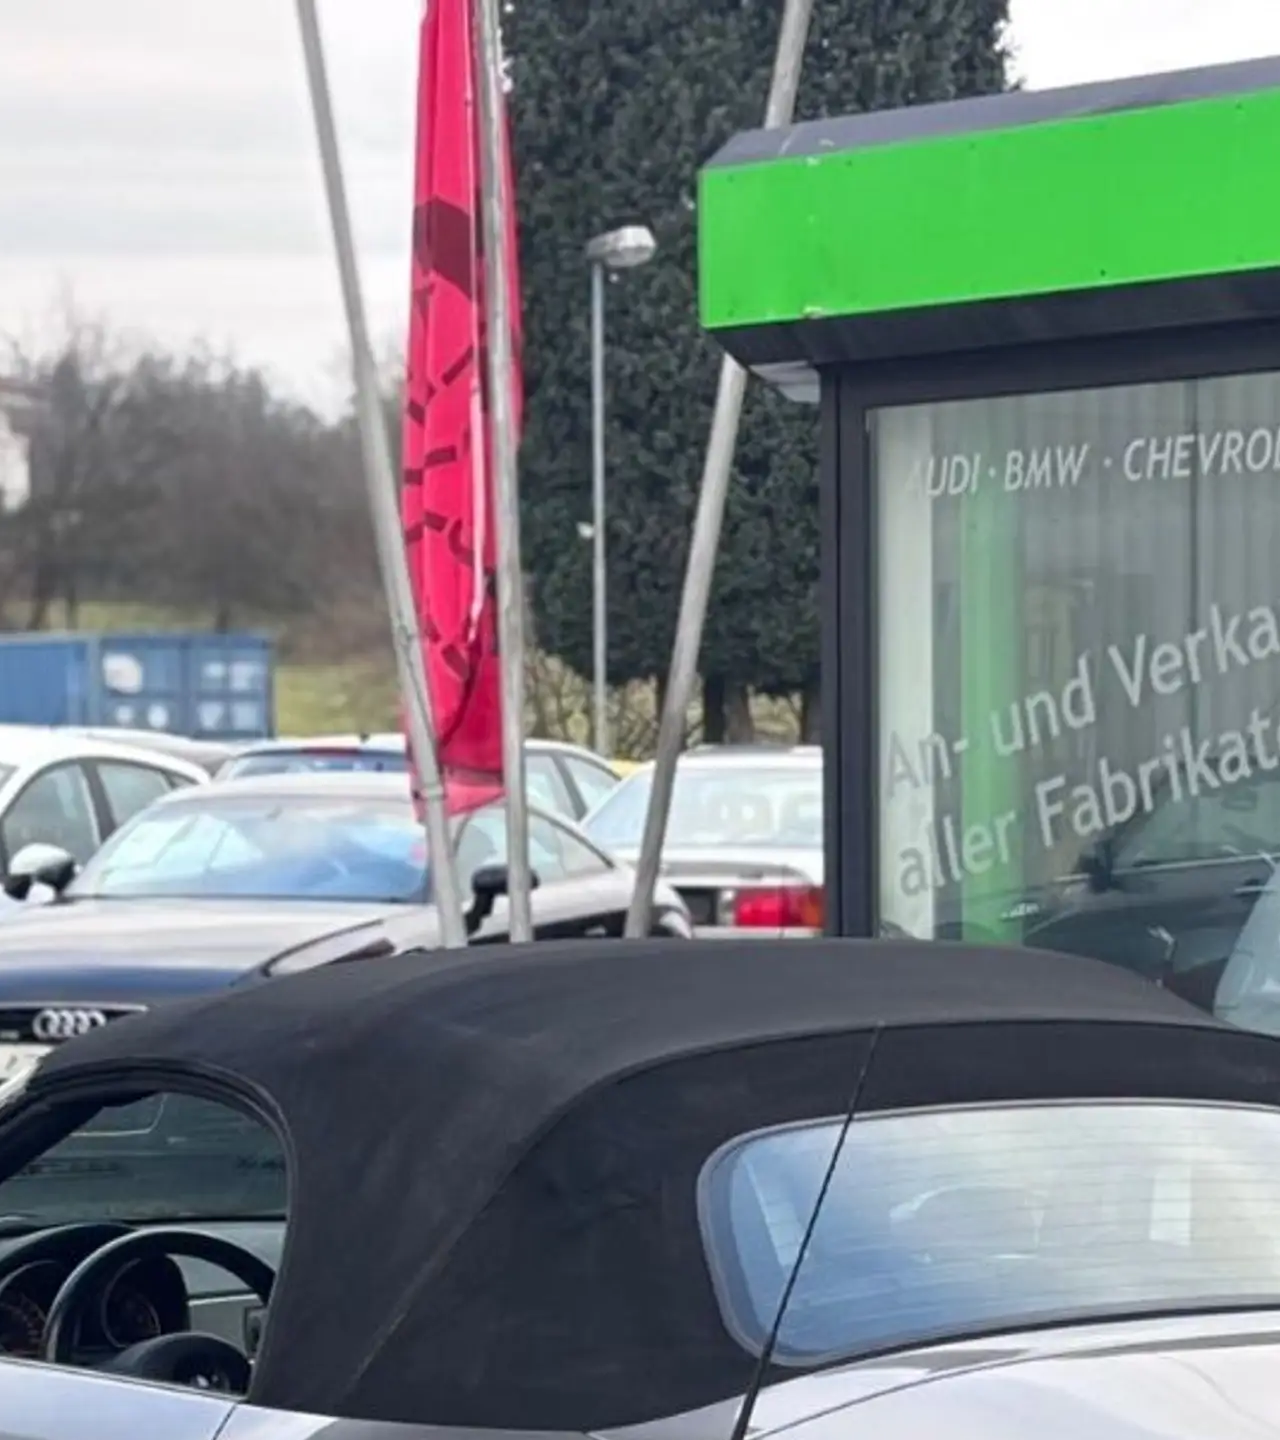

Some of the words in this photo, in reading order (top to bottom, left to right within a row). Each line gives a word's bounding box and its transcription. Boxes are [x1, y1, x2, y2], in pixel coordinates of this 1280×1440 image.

[1004, 443, 1088, 492] BMW
[990, 656, 1096, 757] und
[897, 811, 1017, 897] aller
